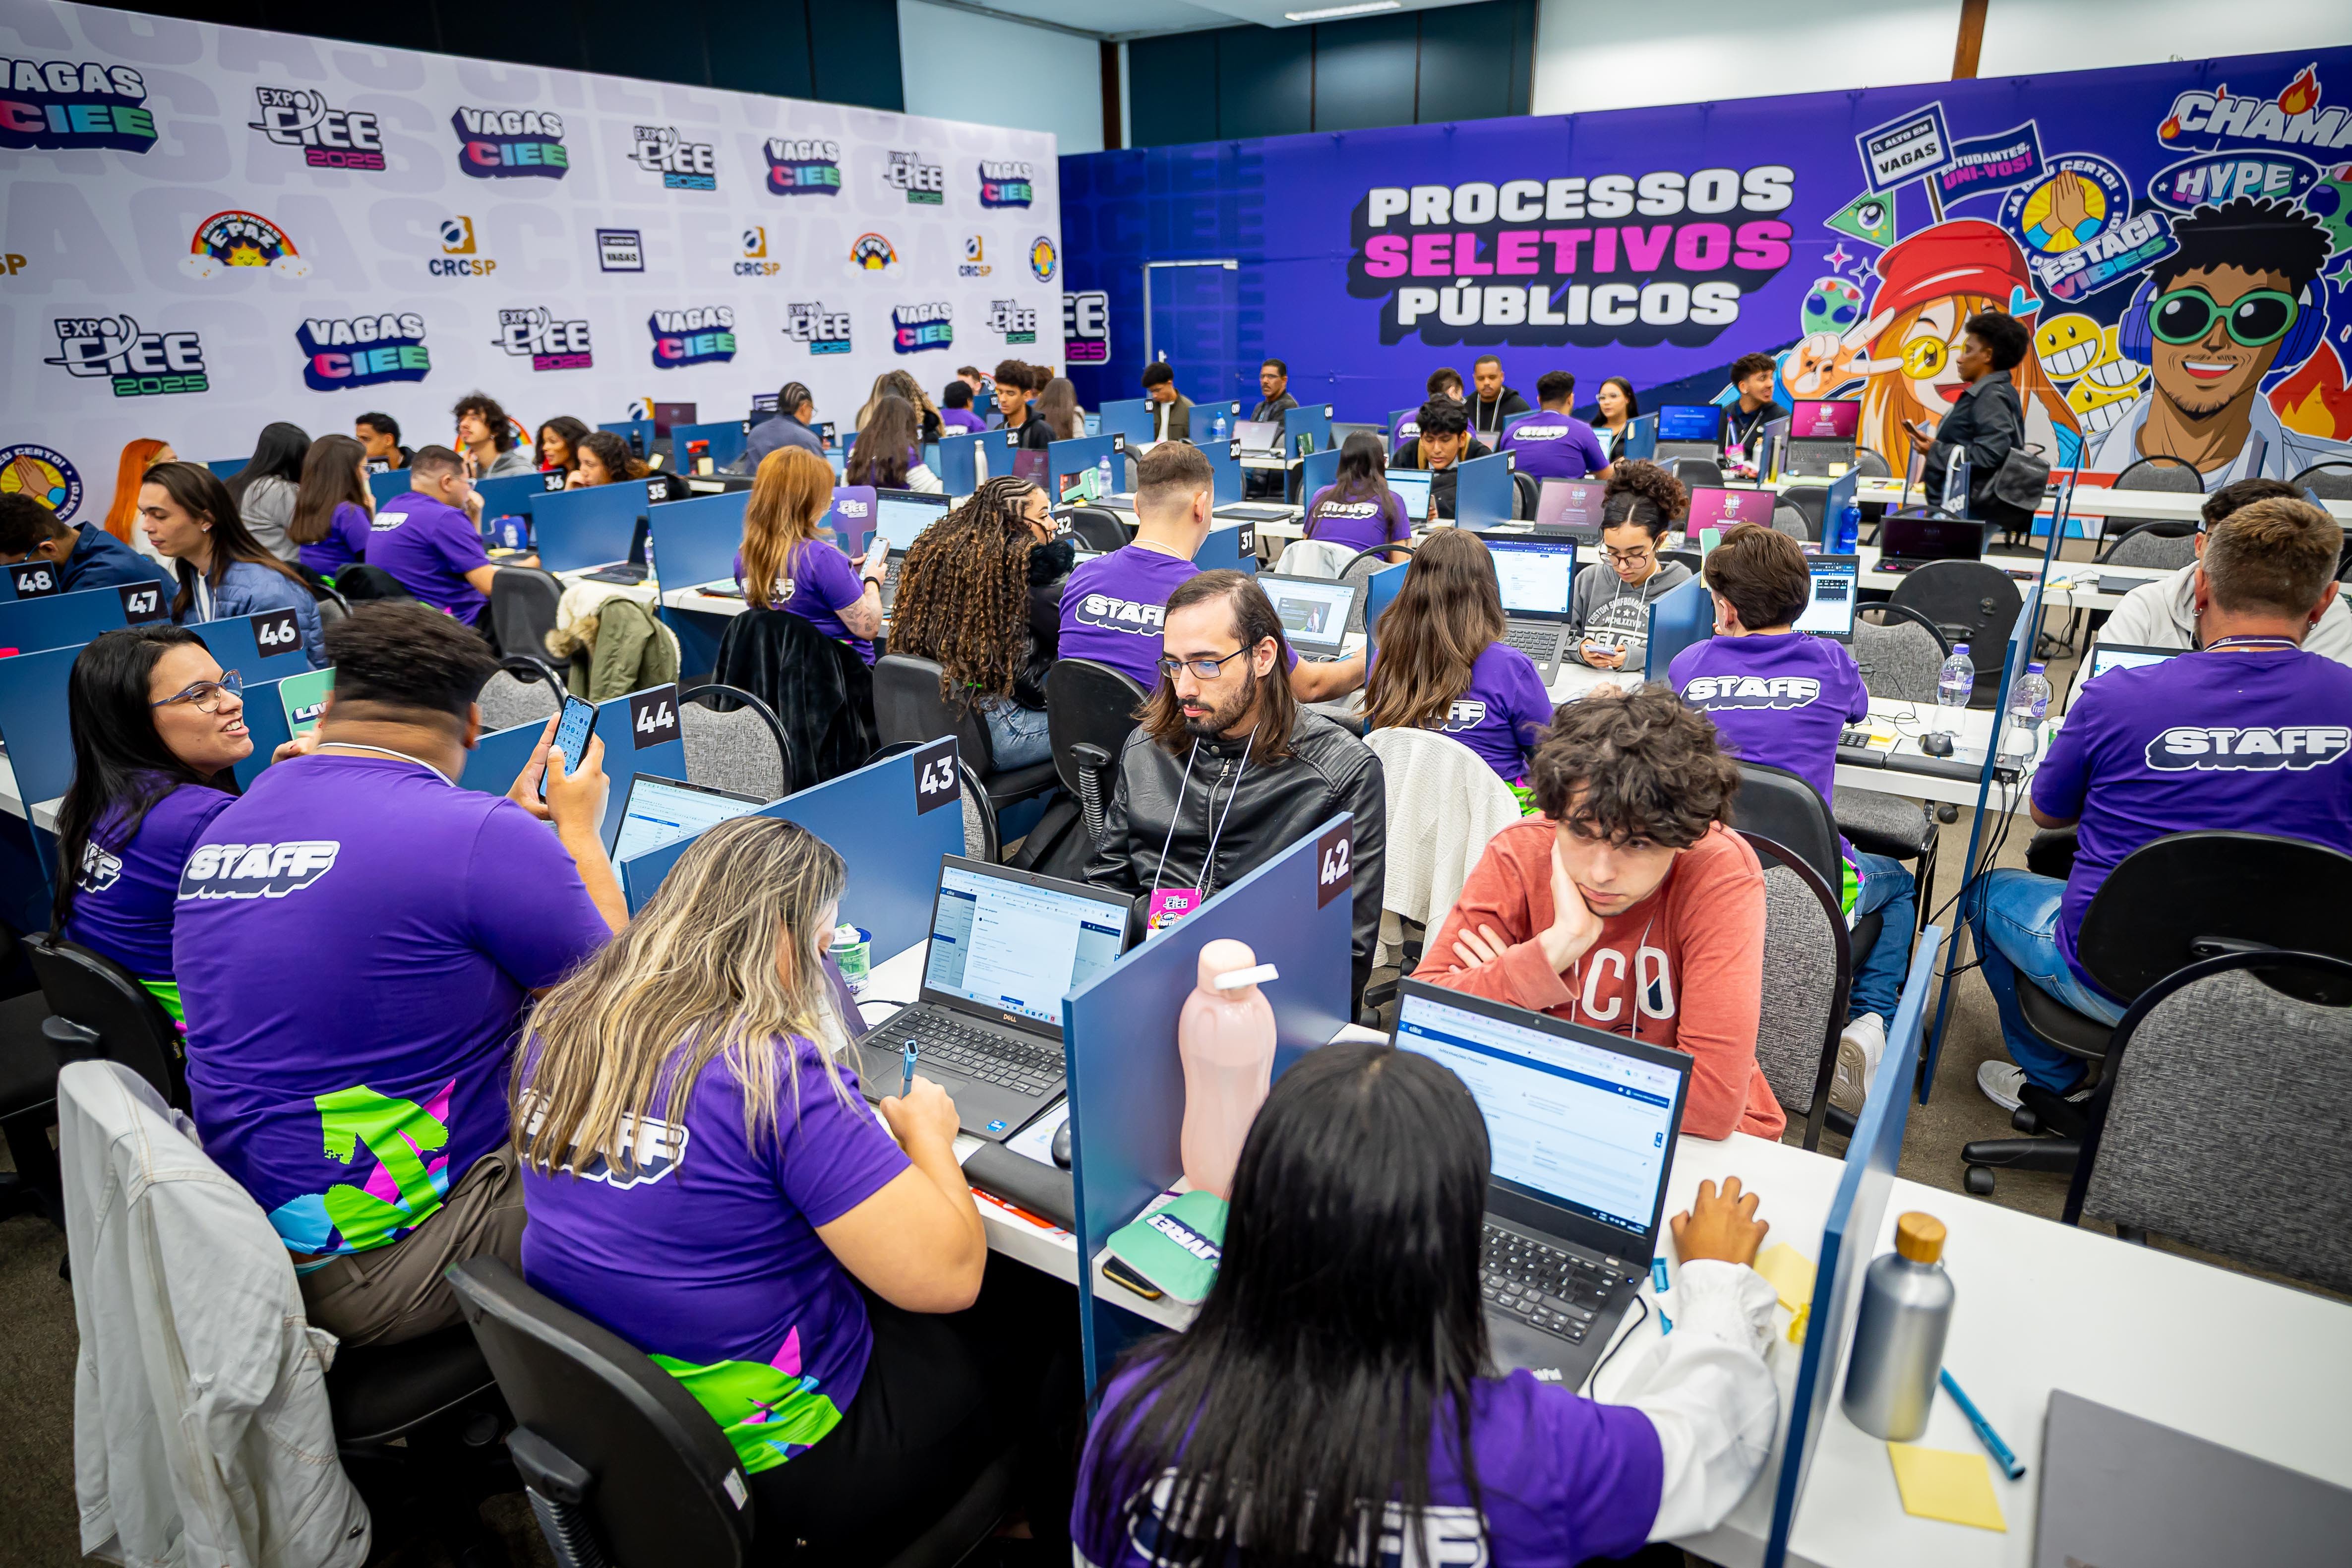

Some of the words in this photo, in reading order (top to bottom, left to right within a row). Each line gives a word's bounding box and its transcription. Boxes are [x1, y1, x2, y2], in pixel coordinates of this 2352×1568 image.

[0, 103, 156, 137] CIEE
[263, 106, 381, 150] CIEE
[461, 108, 563, 137] VAGAS
[1885, 131, 1911, 149] ALTO
[1912, 122, 1930, 137] EM
[306, 150, 385, 169] 2025
[468, 141, 568, 167] CIEE
[639, 140, 714, 174] CIEE
[769, 138, 839, 163] VAGAS
[1878, 142, 1937, 175] VAGAS
[665, 174, 716, 190] 2025
[773, 165, 841, 187] CIEE
[891, 163, 942, 191] CIEE
[982, 161, 1032, 180] VAGAS
[1943, 151, 2033, 191] UNI-VOS!
[2060, 160, 2119, 191] CERTO!
[2175, 161, 2293, 197] HYPE
[983, 183, 1032, 201] CIEE
[1368, 165, 1795, 228] PROCESSOS
[226, 222, 277, 249] PAZ
[2040, 212, 2159, 285] ESTAGI
[1364, 220, 1793, 278] SELETIVOS
[429, 260, 497, 276] CRCSP
[733, 262, 780, 276] CRCSP
[959, 265, 992, 277] CRCSP
[2050, 236, 2167, 298] VIBES
[895, 303, 953, 323] VAGAS
[1397, 278, 1741, 326] PÚBLICOS
[56, 318, 119, 338] EXPO
[306, 314, 426, 346] VAGAS
[654, 306, 733, 332] VAGAS
[790, 313, 849, 342] CIEE
[992, 309, 1036, 332] CIEE
[503, 321, 591, 356] CIEE
[659, 333, 736, 359] CIEE
[810, 341, 851, 354] 2025
[898, 325, 953, 346] CIEE
[61, 332, 203, 377] CIEE
[314, 346, 430, 379] CIEE
[534, 354, 592, 370] 2025
[114, 375, 207, 396] 2025
[1007, 432, 1019, 444] 22
[1114, 438, 1124, 449] 21
[1230, 443, 1241, 456] 20
[14, 447, 66, 468] CERTO!
[545, 475, 564, 490] 36
[648, 483, 667, 500] 35
[1056, 516, 1072, 536] 32
[1241, 530, 1253, 548] 31
[18, 570, 52, 592] 48
[128, 591, 158, 614] 47
[1085, 597, 1164, 627] STAF
[1587, 603, 1610, 625] CUSTOM
[259, 619, 296, 646] 46
[1688, 678, 1817, 701] STAFF
[636, 701, 675, 734] 44
[2164, 729, 2345, 755] STAFF
[920, 755, 954, 794] 43
[188, 844, 336, 879] STAFF
[1321, 838, 1349, 886] 42
[1166, 900, 1187, 908] CIEE
[1003, 1014, 1017, 1023] DELL
